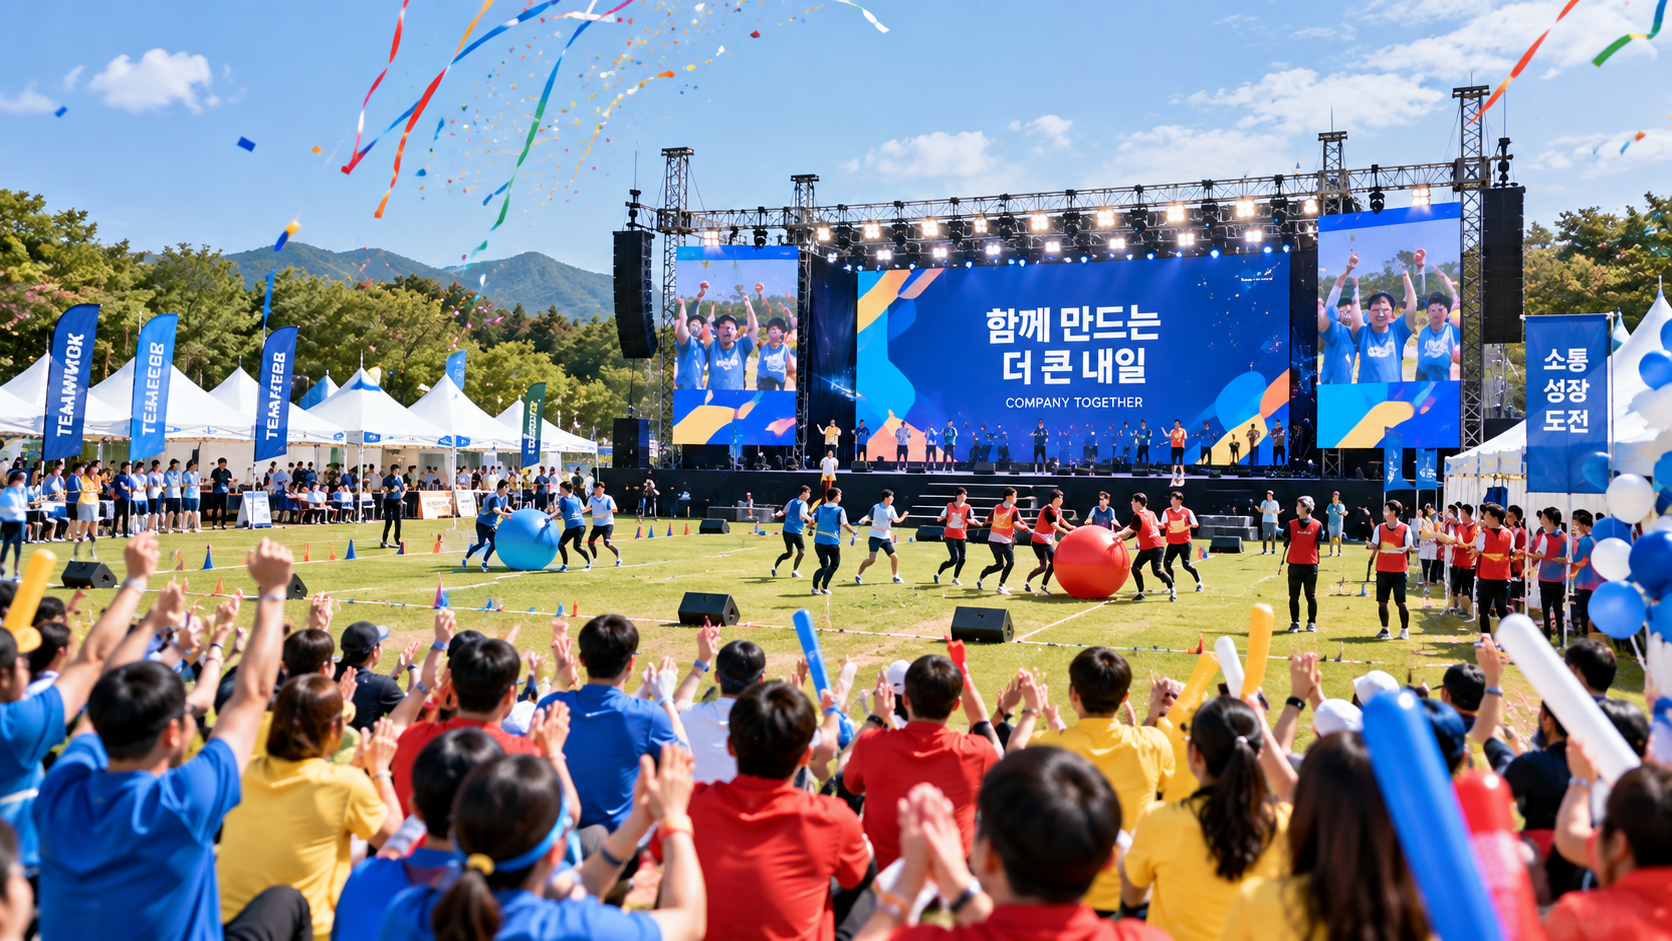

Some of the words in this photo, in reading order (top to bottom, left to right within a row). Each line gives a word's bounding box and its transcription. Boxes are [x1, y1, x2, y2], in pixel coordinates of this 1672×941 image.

[986, 307, 1051, 344] 함께
[1060, 304, 1161, 342] 만드는
[1003, 351, 1032, 385] 더
[1082, 347, 1146, 384] 내일
[1543, 347, 1589, 373] 소통
[1005, 397, 1070, 409] COMPANY
[1073, 396, 1143, 408] TOGETHER
[1543, 378, 1591, 403] 성장
[1543, 409, 1589, 434] 도전
